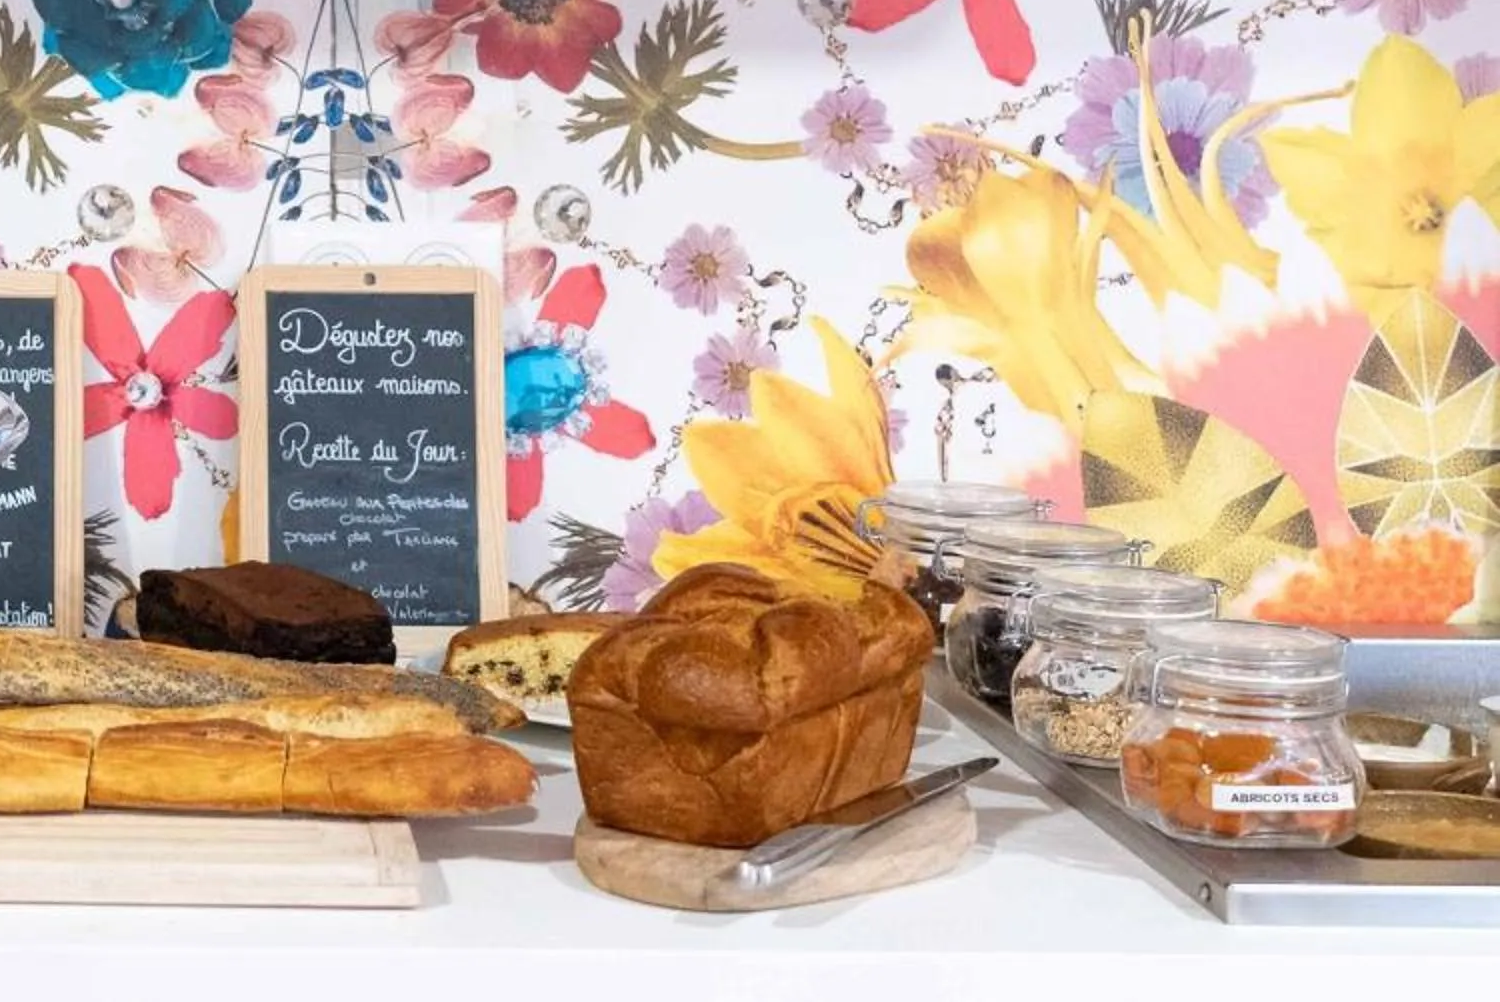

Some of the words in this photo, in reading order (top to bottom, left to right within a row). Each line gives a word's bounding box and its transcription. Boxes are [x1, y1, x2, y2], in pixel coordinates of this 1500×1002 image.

[17, 329, 45, 352] de
[278, 307, 416, 367] Dégustez
[421, 328, 464, 348] nos
[274, 369, 364, 405] gâteaux
[279, 421, 361, 469] Recette
[370, 439, 399, 462] du
[1230, 792, 1299, 803] ABRICOTS
[1303, 792, 1339, 803] SECS
